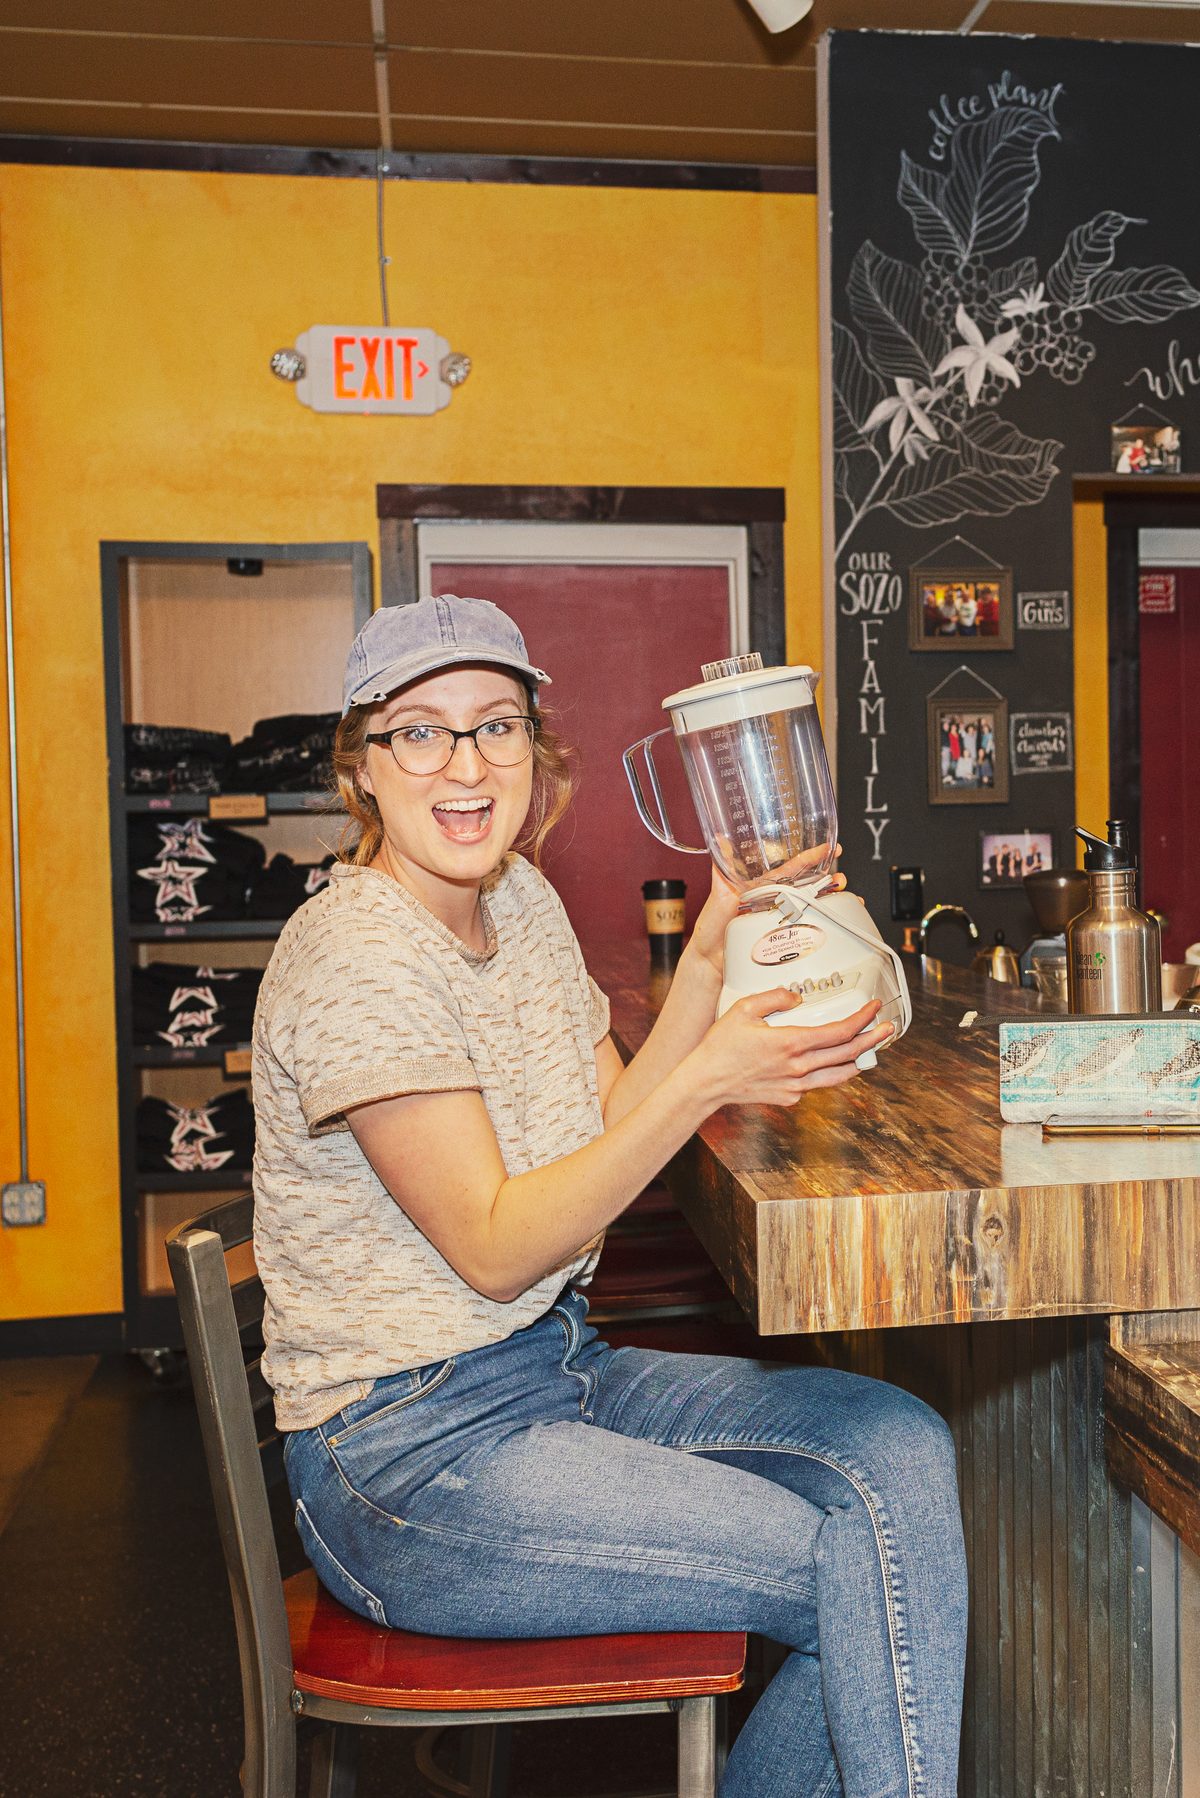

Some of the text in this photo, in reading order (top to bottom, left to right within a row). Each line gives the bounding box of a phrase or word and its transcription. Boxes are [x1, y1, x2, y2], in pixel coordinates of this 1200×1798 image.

[987, 69, 1066, 126] plant
[333, 336, 418, 401] EXIT
[1123, 340, 1200, 400] wh
[848, 552, 893, 571] OUR
[839, 571, 903, 616] SOZO
[859, 620, 890, 861] FAMILY
